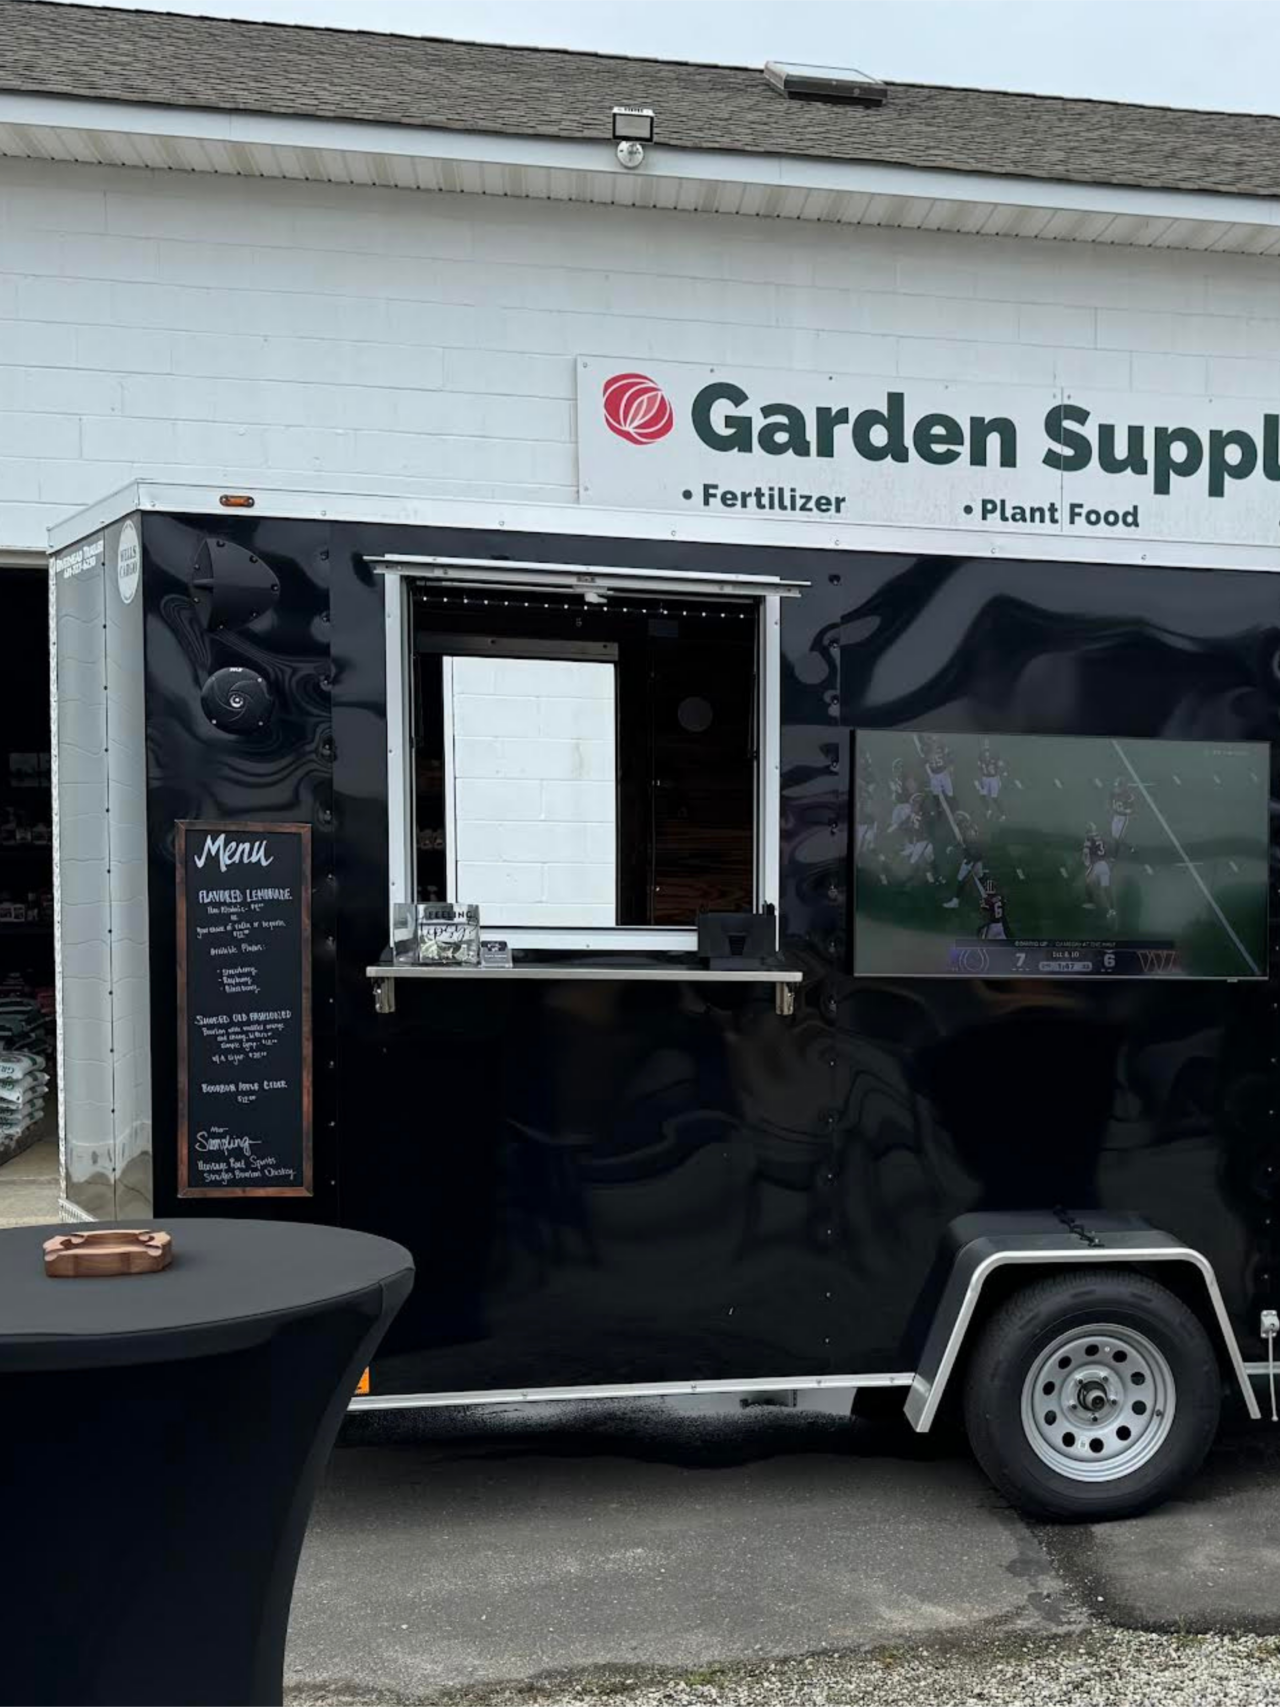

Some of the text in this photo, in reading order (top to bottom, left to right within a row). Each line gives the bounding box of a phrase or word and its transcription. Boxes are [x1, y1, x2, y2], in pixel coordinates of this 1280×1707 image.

[691, 382, 1017, 468] Garden
[703, 484, 846, 514] Fertilizer
[981, 499, 1140, 528] Plant Food
[194, 833, 274, 873] Menu
[1015, 952, 1027, 967] 7
[1103, 953, 1116, 967] 6
